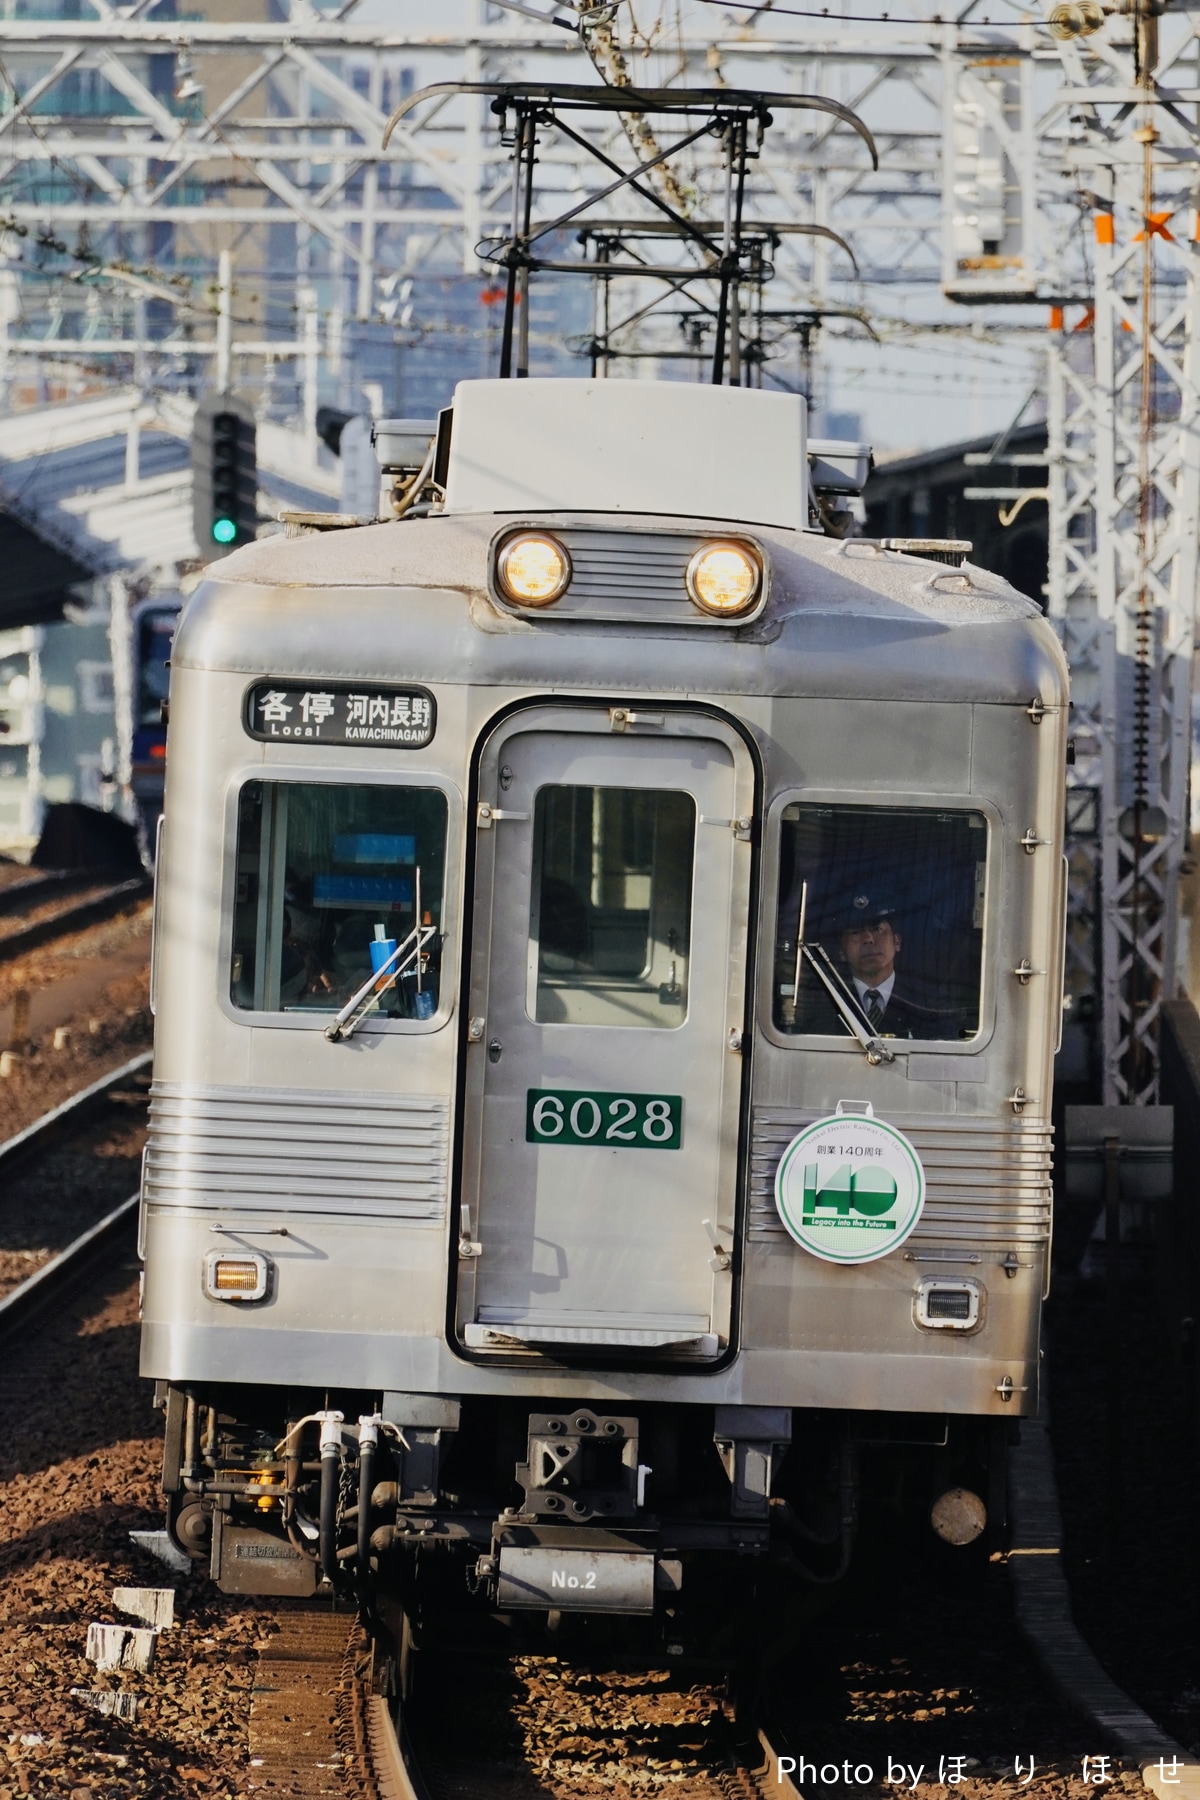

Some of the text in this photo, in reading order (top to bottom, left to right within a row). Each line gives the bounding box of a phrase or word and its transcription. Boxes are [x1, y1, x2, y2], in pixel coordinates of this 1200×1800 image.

[258, 690, 430, 728] 各停 河内長野
[271, 723, 320, 737] Local
[532, 1095, 674, 1142] 6028
[802, 1162, 898, 1217] 140
[811, 1217, 888, 1228] Legacy into the Future
[551, 1570, 597, 1590] No.2
